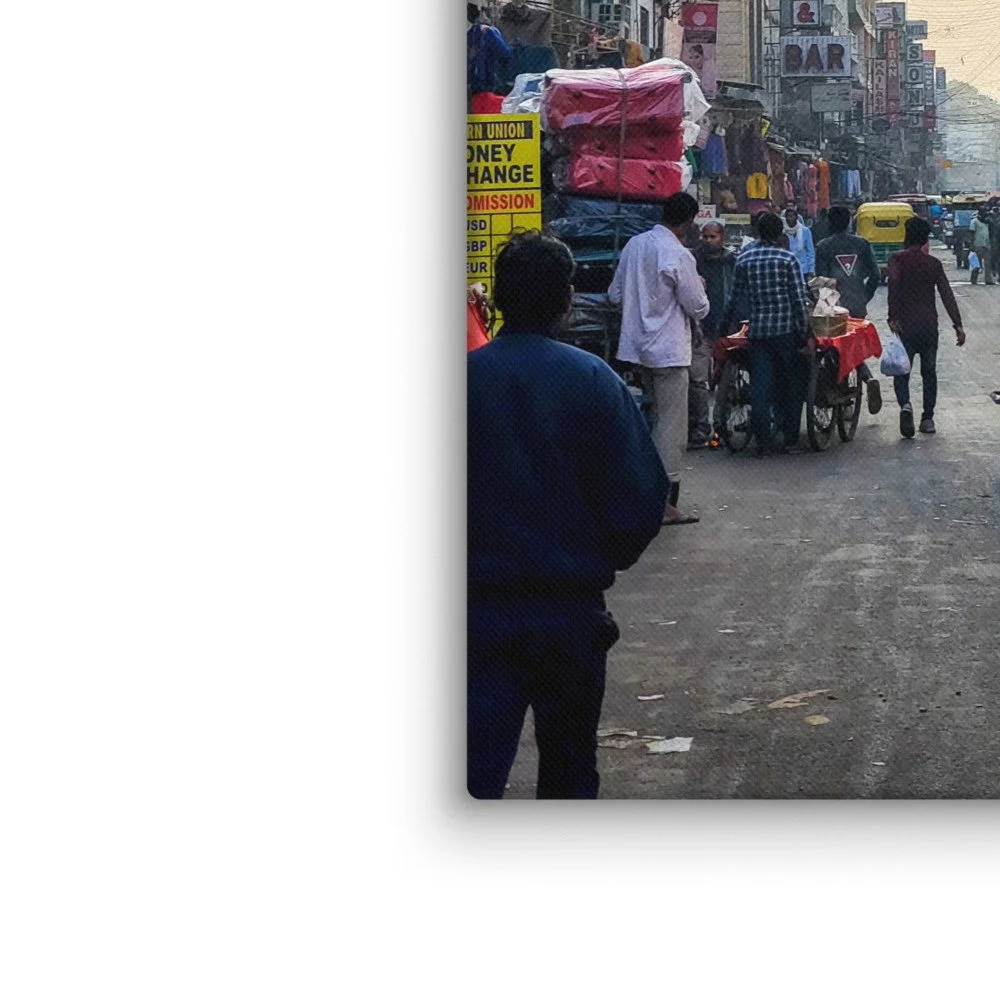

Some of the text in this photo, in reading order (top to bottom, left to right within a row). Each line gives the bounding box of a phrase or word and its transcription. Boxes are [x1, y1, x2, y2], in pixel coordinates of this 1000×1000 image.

[797, 2, 814, 23] &
[785, 43, 845, 74] BAR
[487, 122, 525, 139] UNION
